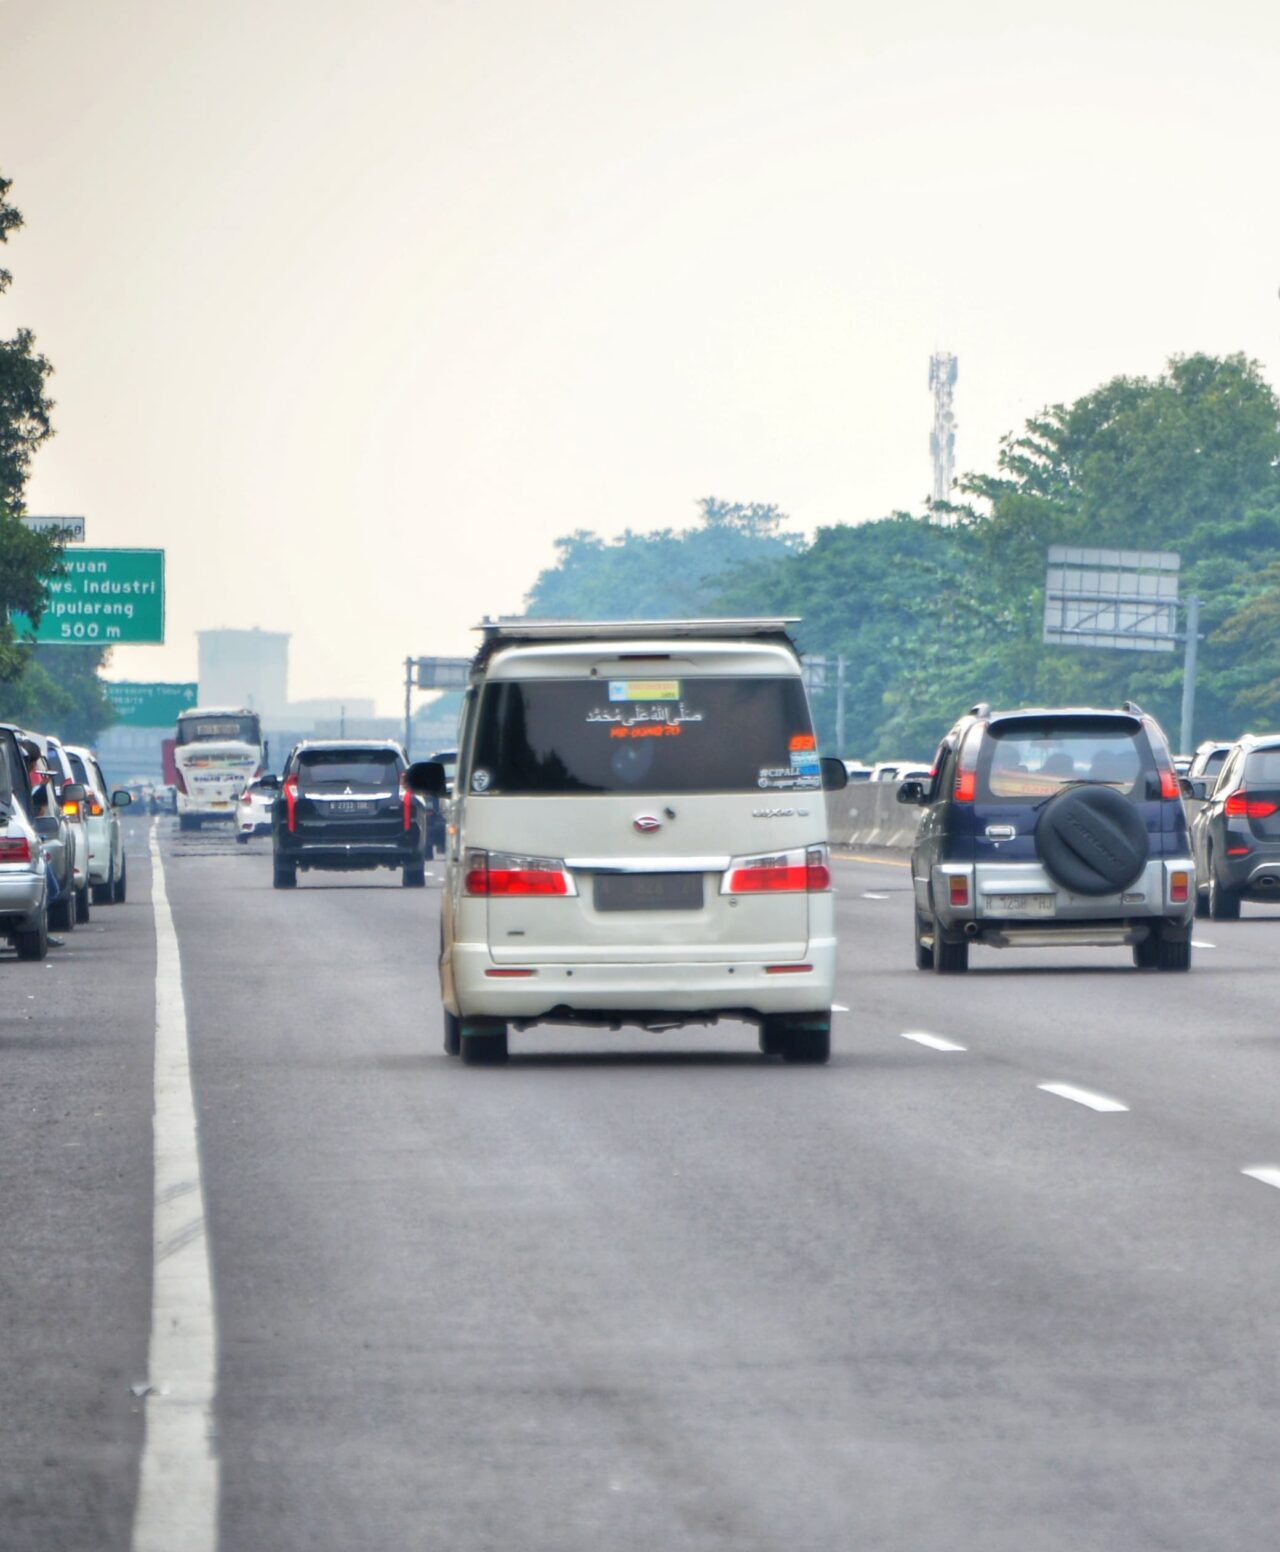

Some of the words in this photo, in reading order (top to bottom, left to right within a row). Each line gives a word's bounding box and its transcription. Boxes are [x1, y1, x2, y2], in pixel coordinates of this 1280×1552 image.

[84, 579, 156, 594] Industri
[61, 624, 98, 637] 500
[106, 628, 121, 637] m
